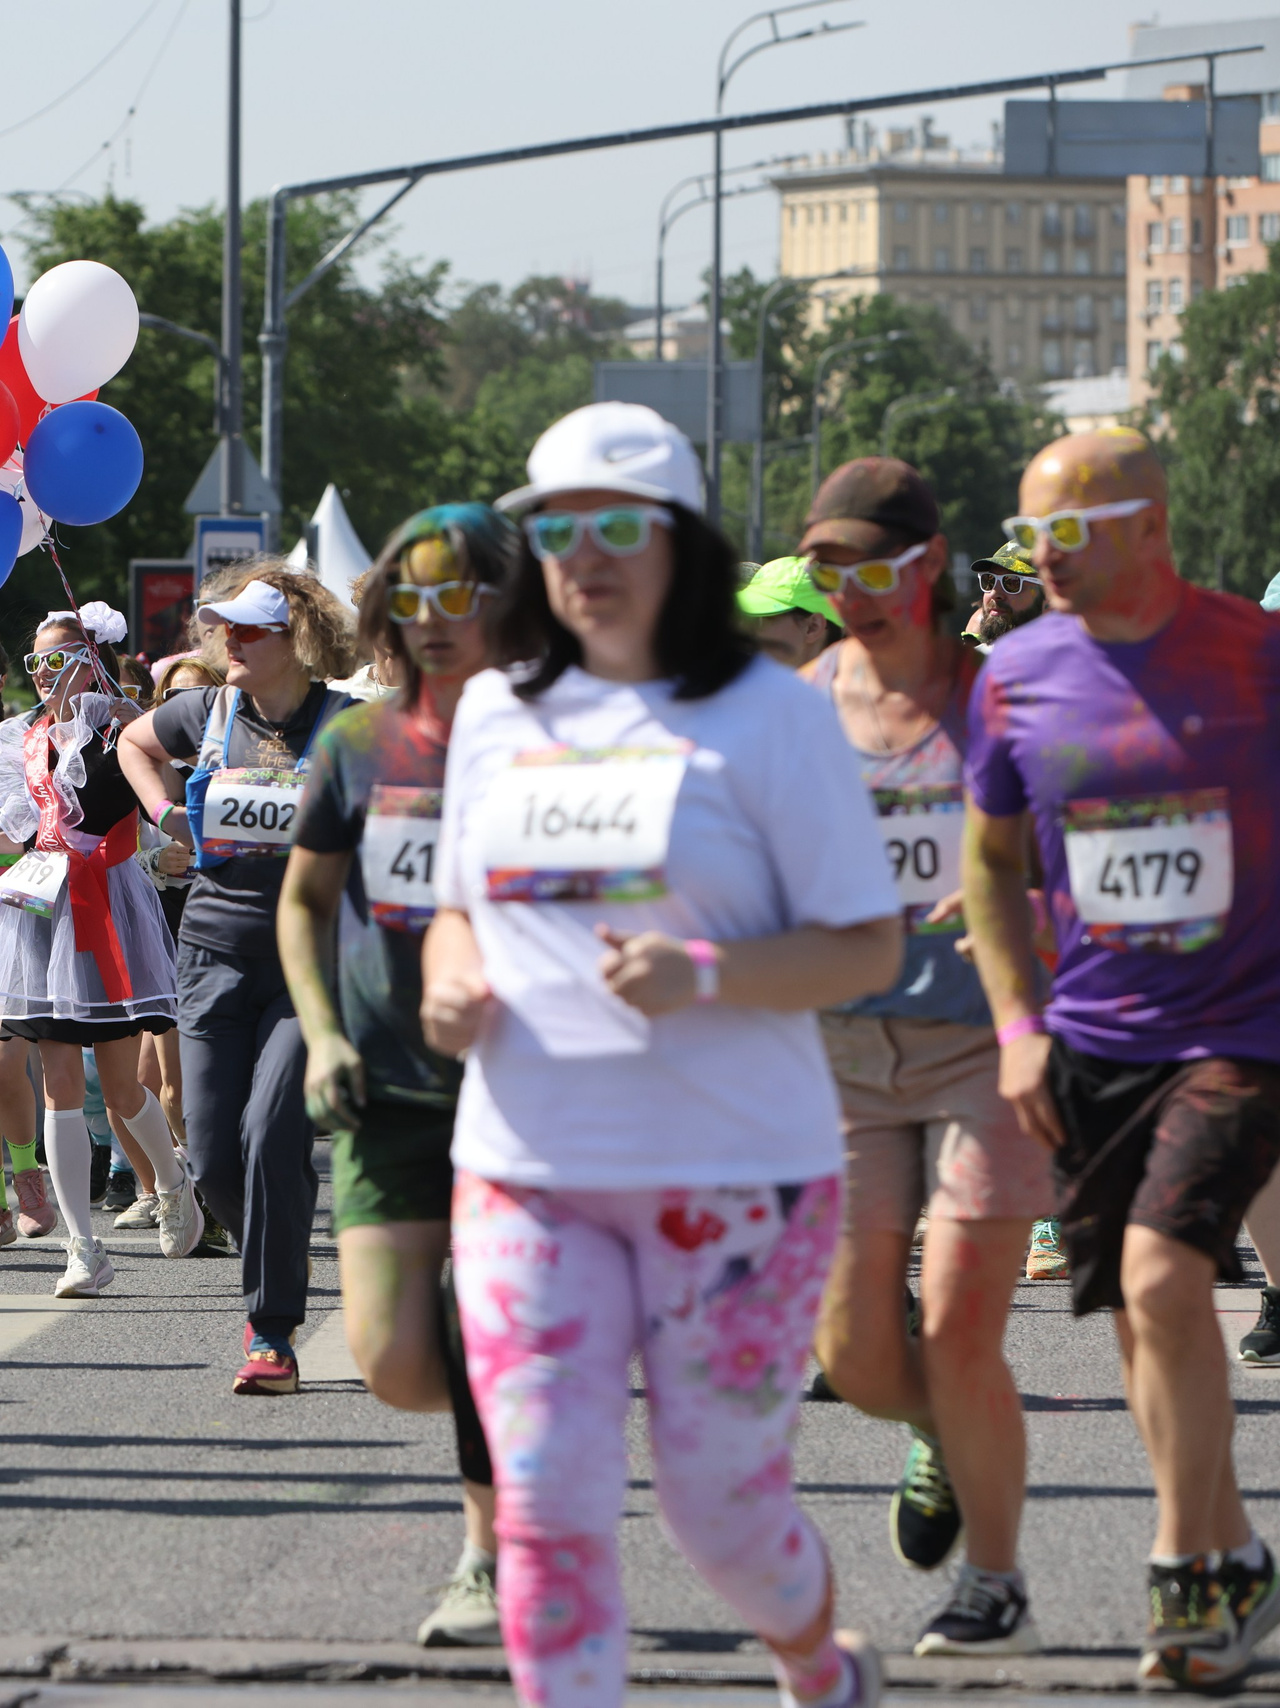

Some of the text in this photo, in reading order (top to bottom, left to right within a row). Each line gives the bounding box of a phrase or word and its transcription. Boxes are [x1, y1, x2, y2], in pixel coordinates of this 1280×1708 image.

[257, 740, 291, 753] FEEL
[258, 753, 287, 768] THE
[220, 797, 298, 831] 2602
[523, 792, 637, 838] 1644
[7, 860, 54, 885] 1919
[1098, 849, 1202, 897] 4179
